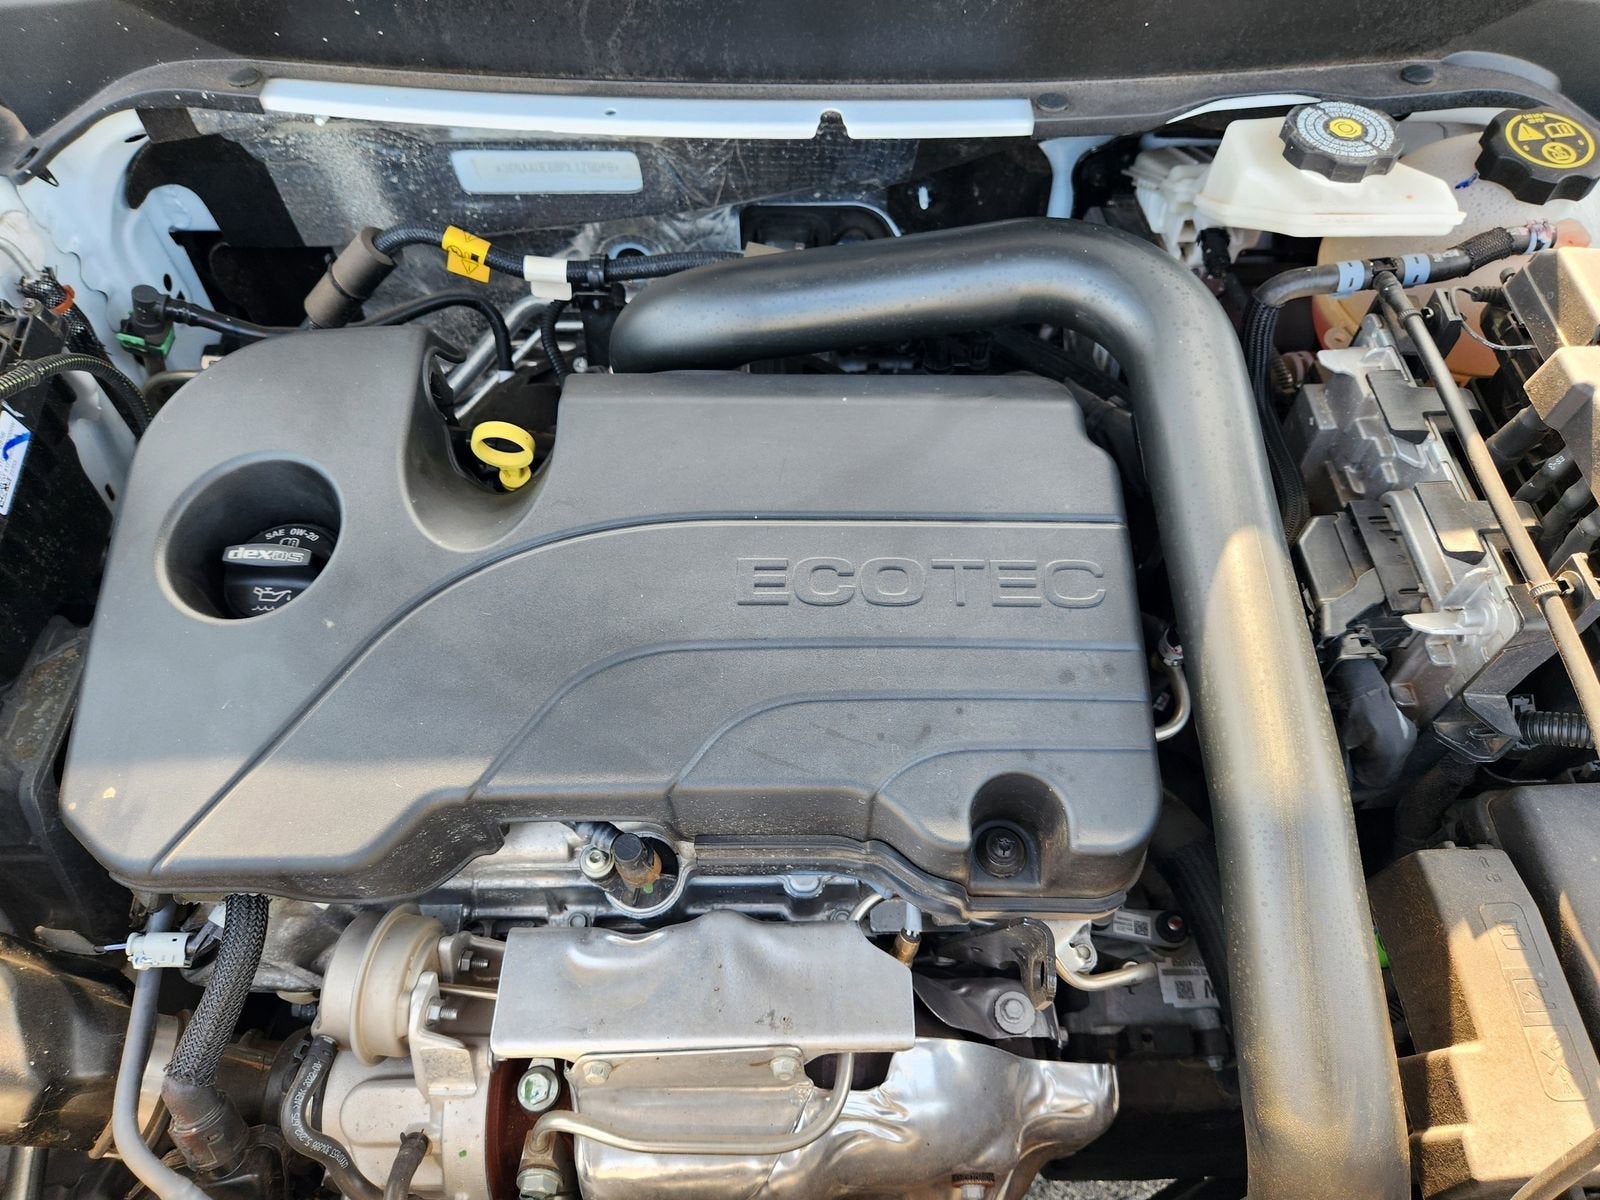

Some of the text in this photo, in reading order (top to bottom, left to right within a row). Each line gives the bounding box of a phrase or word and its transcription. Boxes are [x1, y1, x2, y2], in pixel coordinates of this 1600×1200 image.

[265, 528, 320, 542] SAE 0W-20
[227, 547, 305, 563] dexos
[736, 556, 1107, 609] ECOTEC
